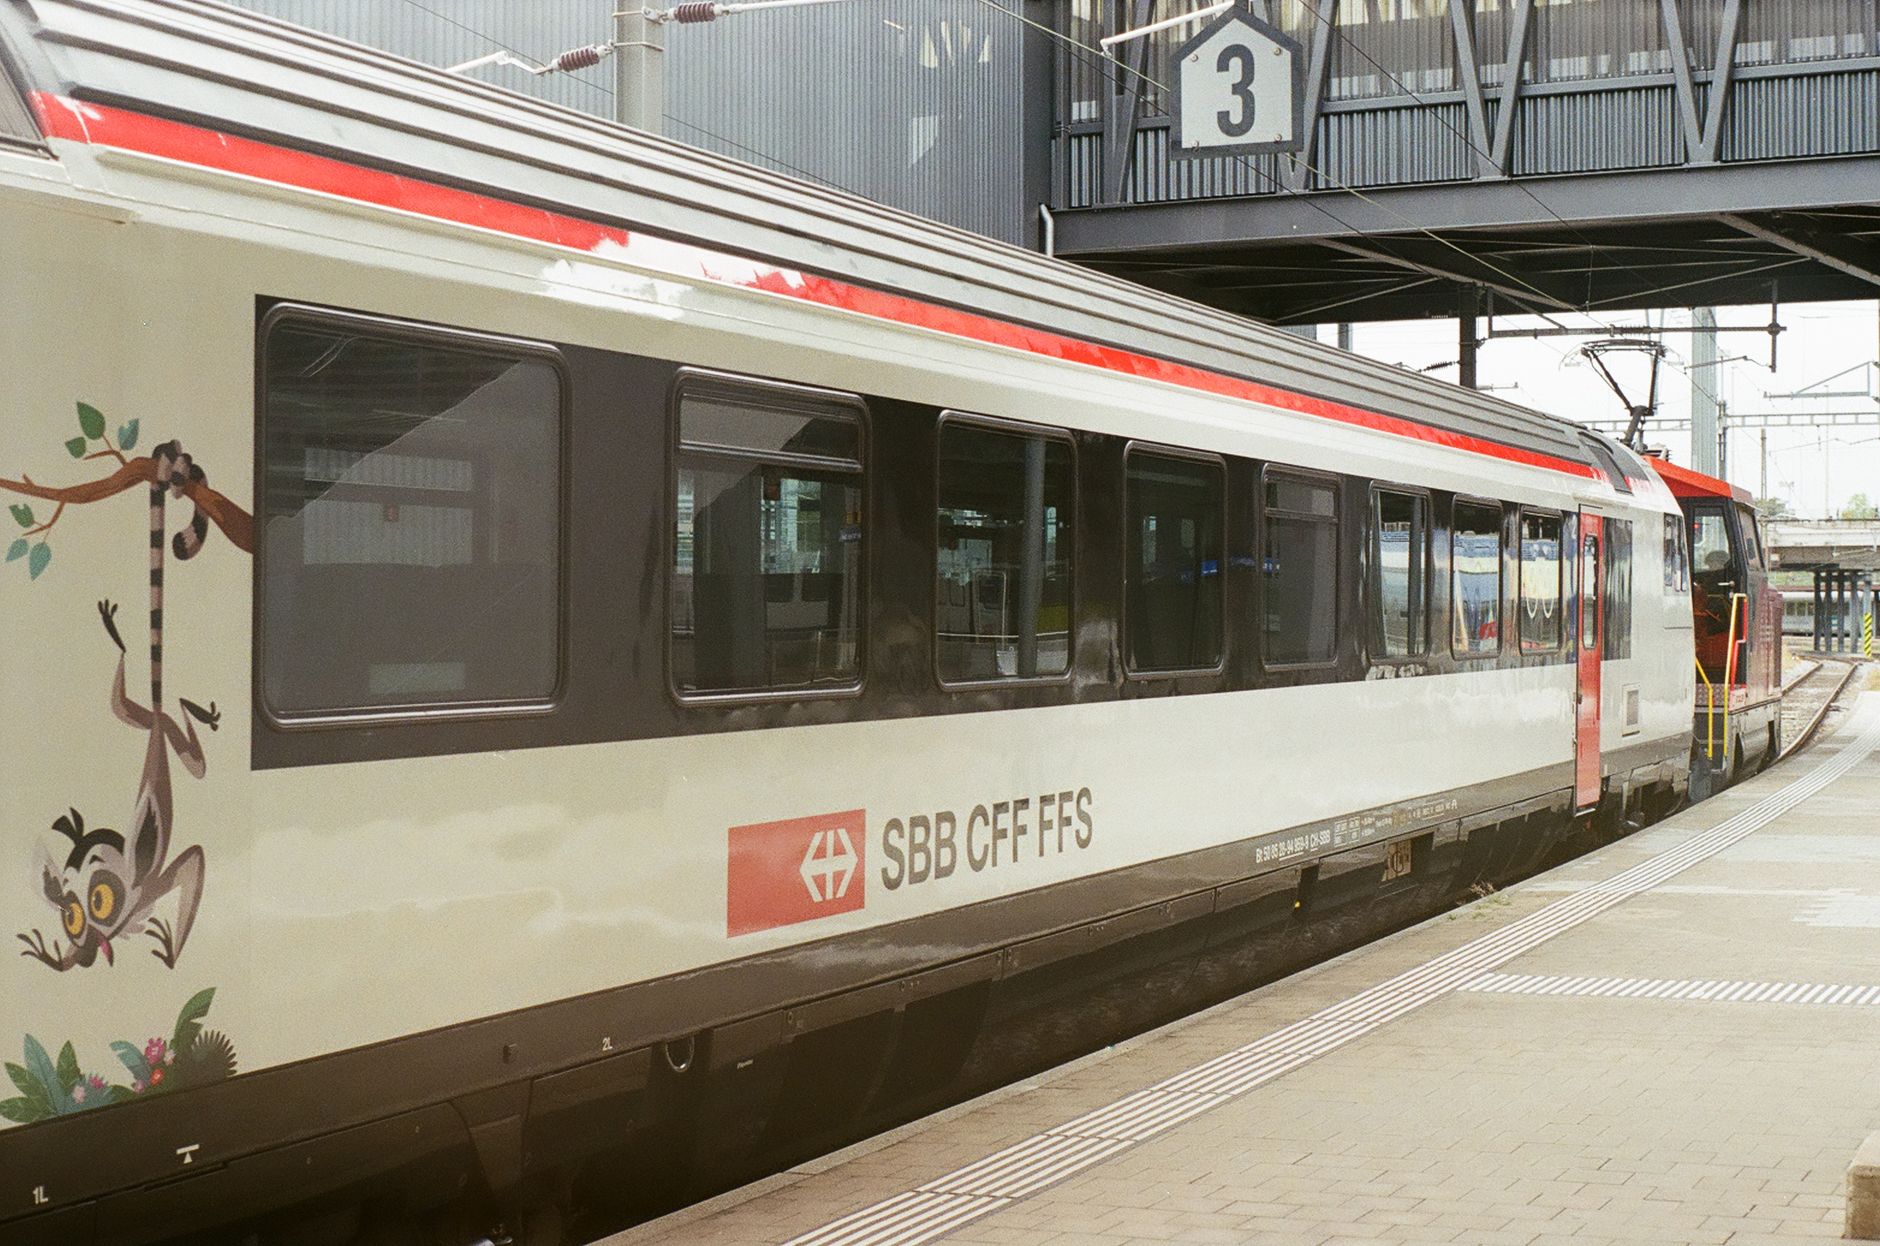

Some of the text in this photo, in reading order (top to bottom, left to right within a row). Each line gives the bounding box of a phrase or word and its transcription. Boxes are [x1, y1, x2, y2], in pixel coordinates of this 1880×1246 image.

[1216, 43, 1255, 138] 3
[881, 786, 1093, 891] SBB CFF FFS
[602, 1036, 613, 1052] 2L
[32, 1185, 49, 1205] 1L
